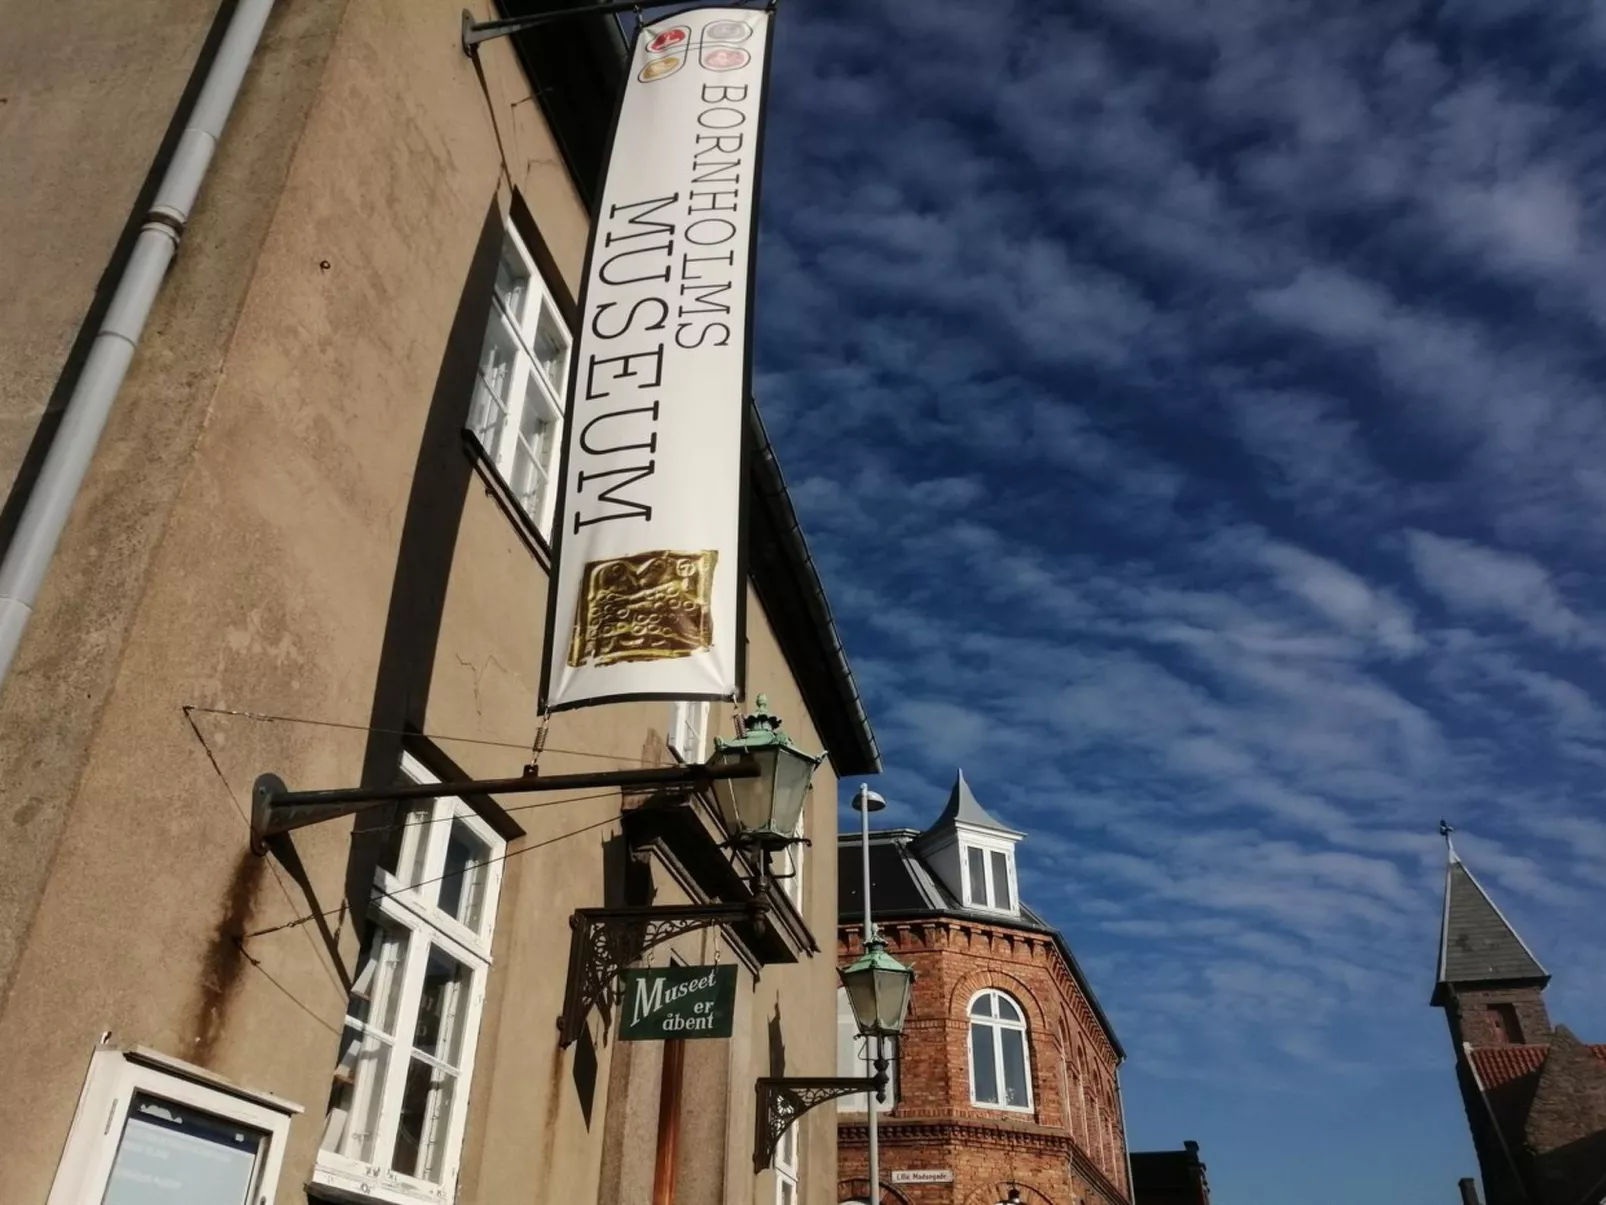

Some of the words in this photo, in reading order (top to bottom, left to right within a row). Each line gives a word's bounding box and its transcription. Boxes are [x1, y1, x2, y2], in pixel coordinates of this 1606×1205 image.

[675, 83, 748, 349] BORNHOLMS
[574, 192, 679, 535] MUSEUM
[630, 968, 717, 1027] Museet
[662, 1012, 714, 1031] åbent
[693, 1001, 714, 1014] er
